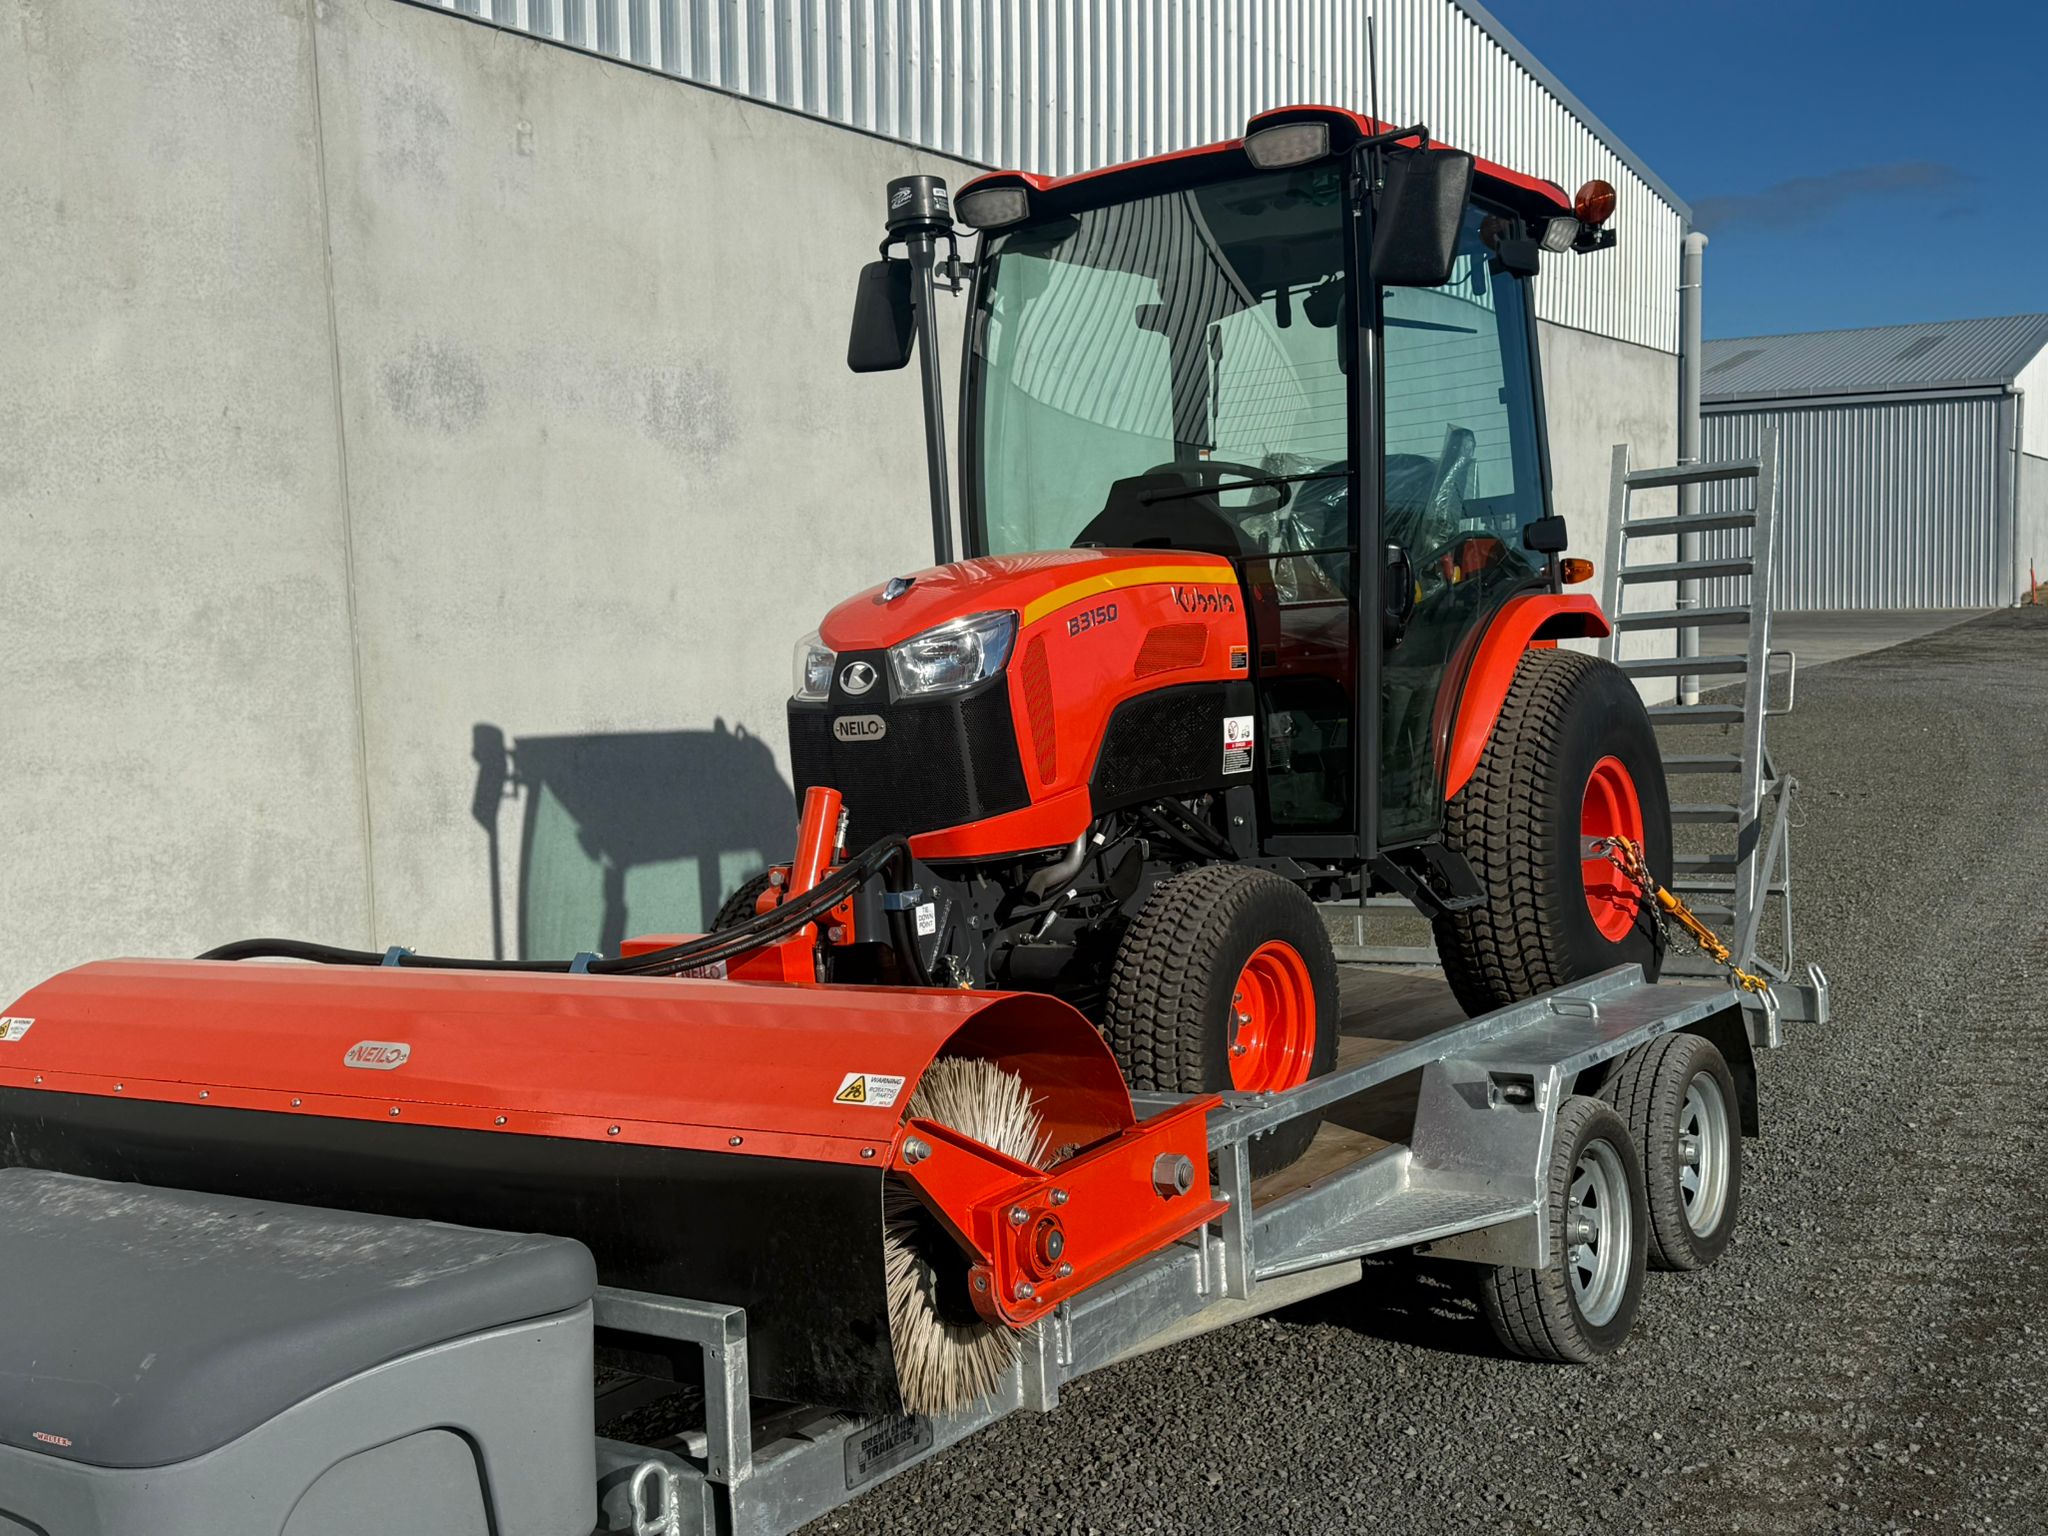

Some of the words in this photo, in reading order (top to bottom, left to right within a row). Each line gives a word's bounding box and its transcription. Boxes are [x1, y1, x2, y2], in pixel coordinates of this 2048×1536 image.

[1171, 586, 1235, 613] Kubota
[1067, 604, 1118, 637] B3150
[839, 720, 879, 736] NEILO
[918, 913, 934, 922] DOWN
[919, 920, 934, 929] POINT
[350, 1046, 402, 1064] NEILO
[870, 1076, 903, 1085] WARNING
[869, 1086, 898, 1094] ROTATING
[861, 1428, 889, 1452] BRENT
[866, 1427, 914, 1461] TRAILERS
